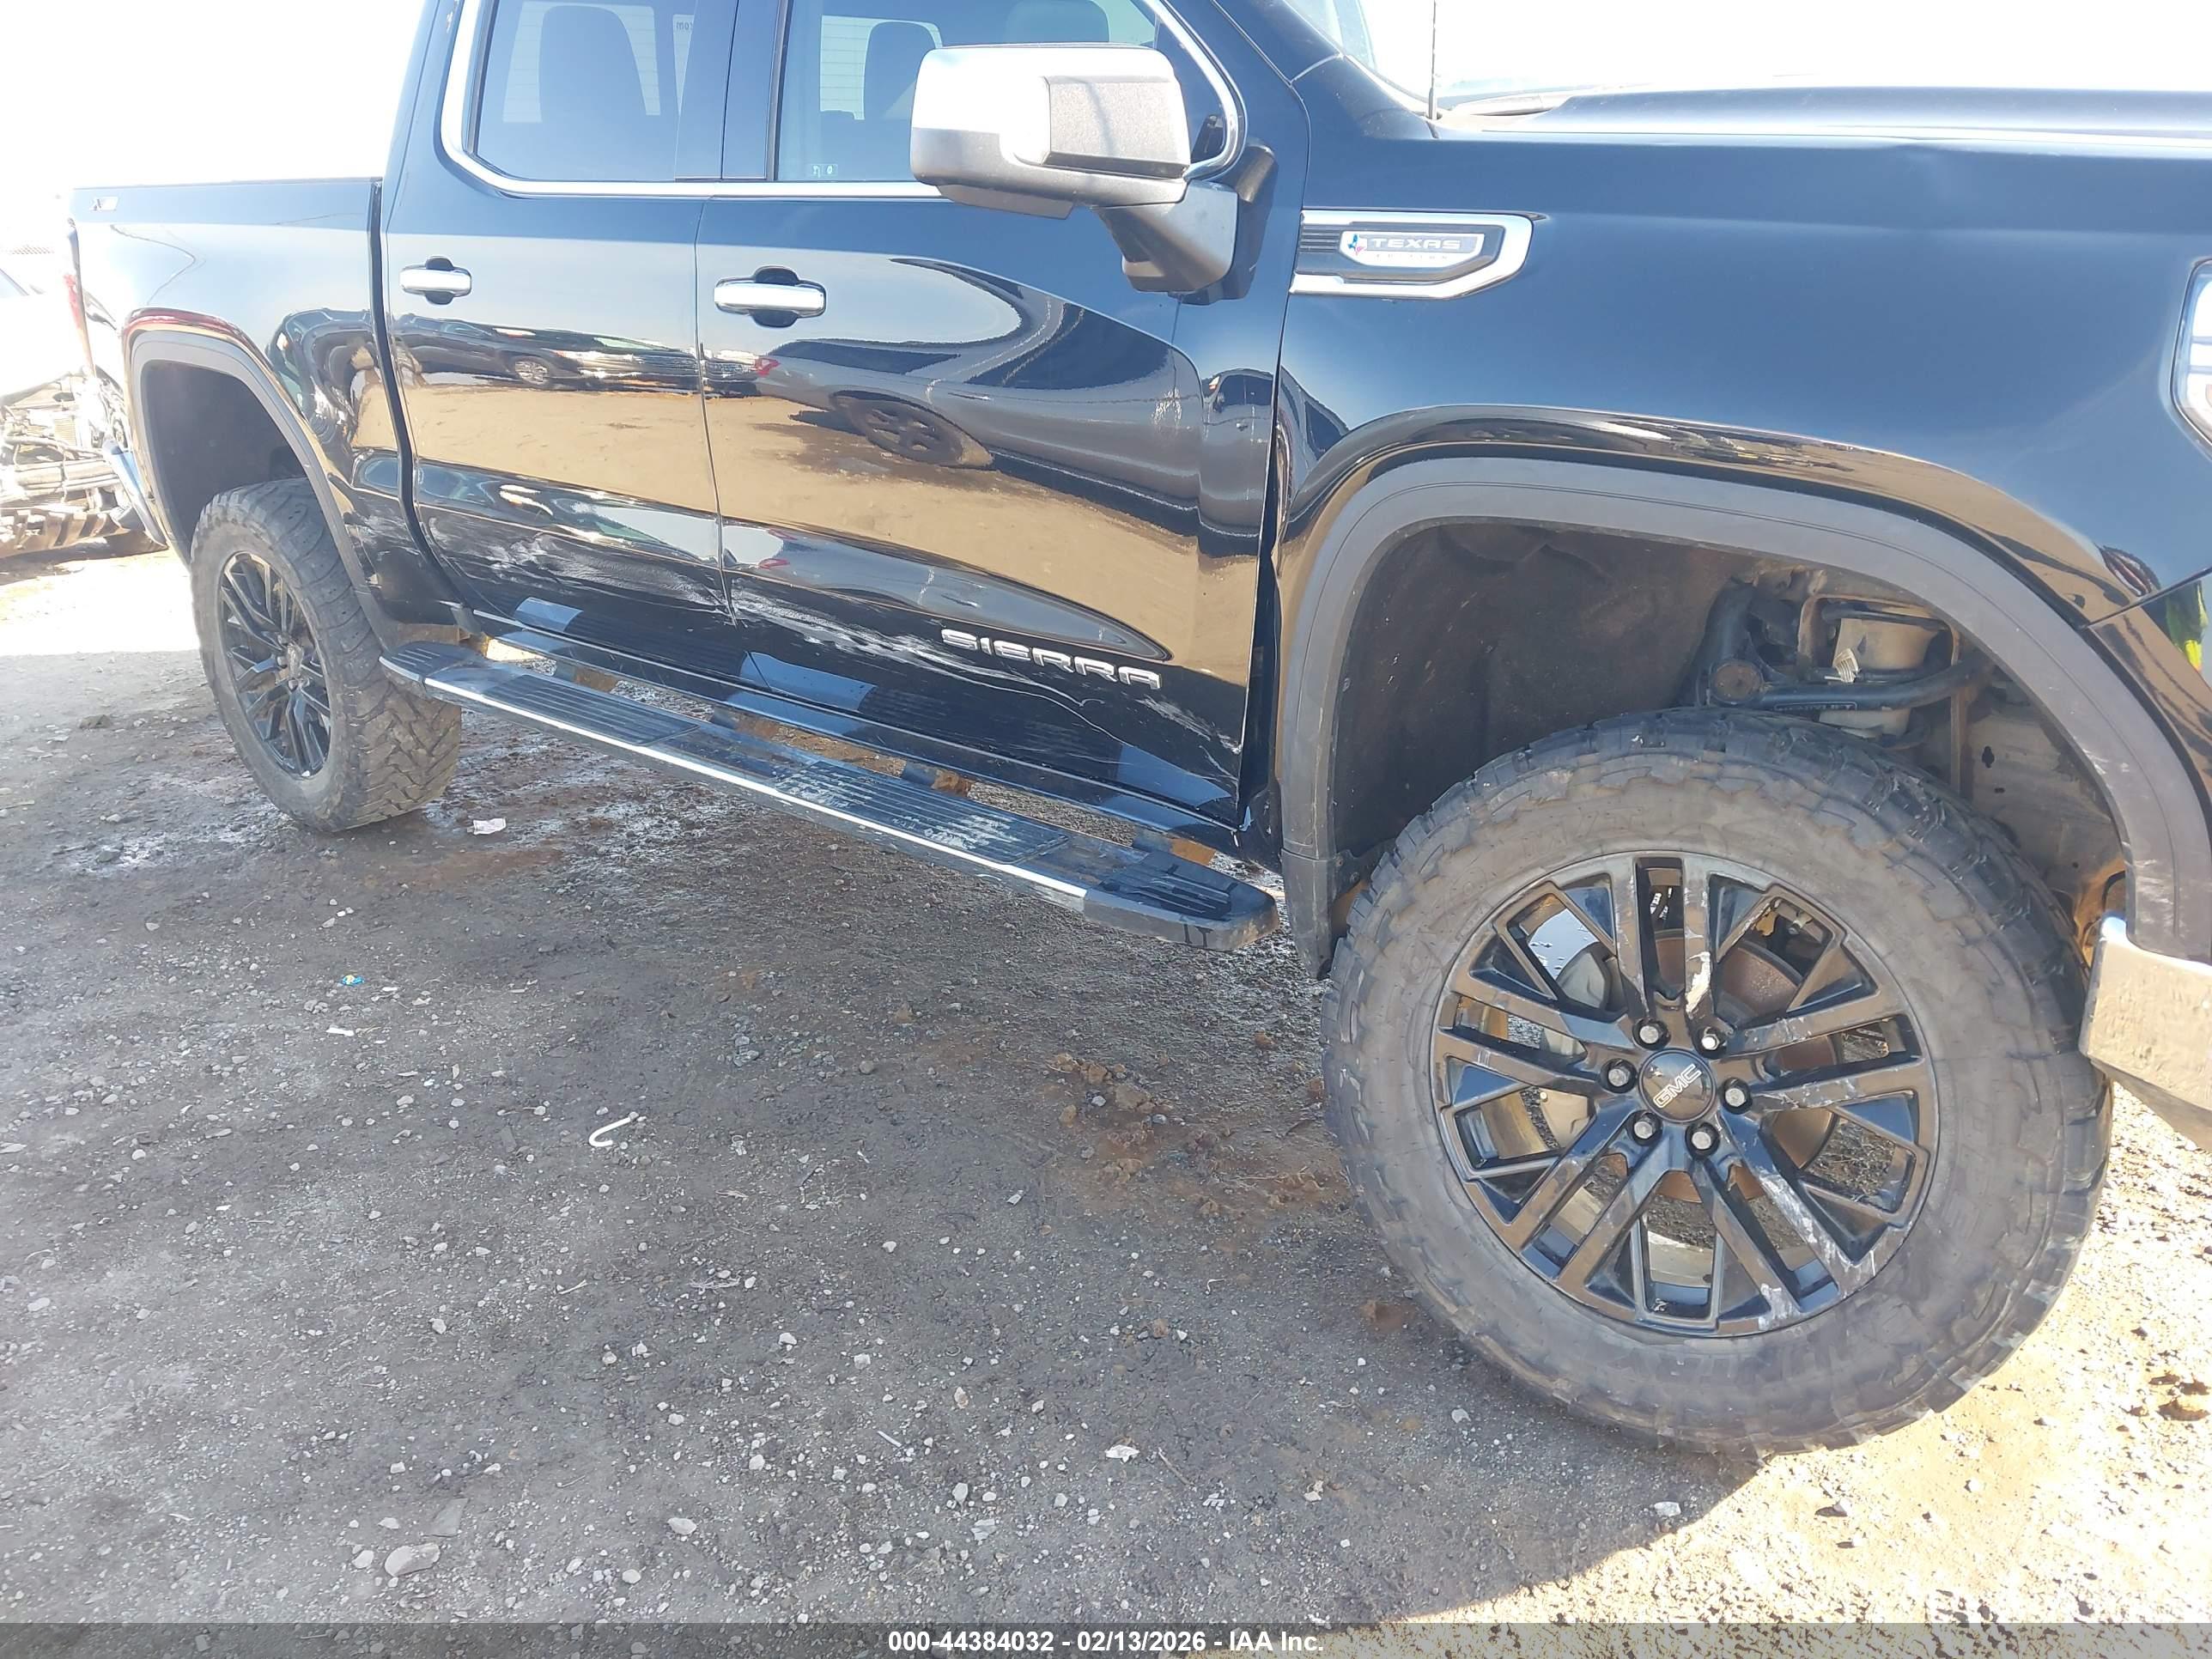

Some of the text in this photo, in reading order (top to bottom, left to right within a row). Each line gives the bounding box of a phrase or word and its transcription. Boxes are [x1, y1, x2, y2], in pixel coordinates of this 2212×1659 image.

[1370, 237, 1462, 251] TEXAS
[941, 629, 1162, 690] SIERRA
[1652, 1063, 1703, 1109] GMC
